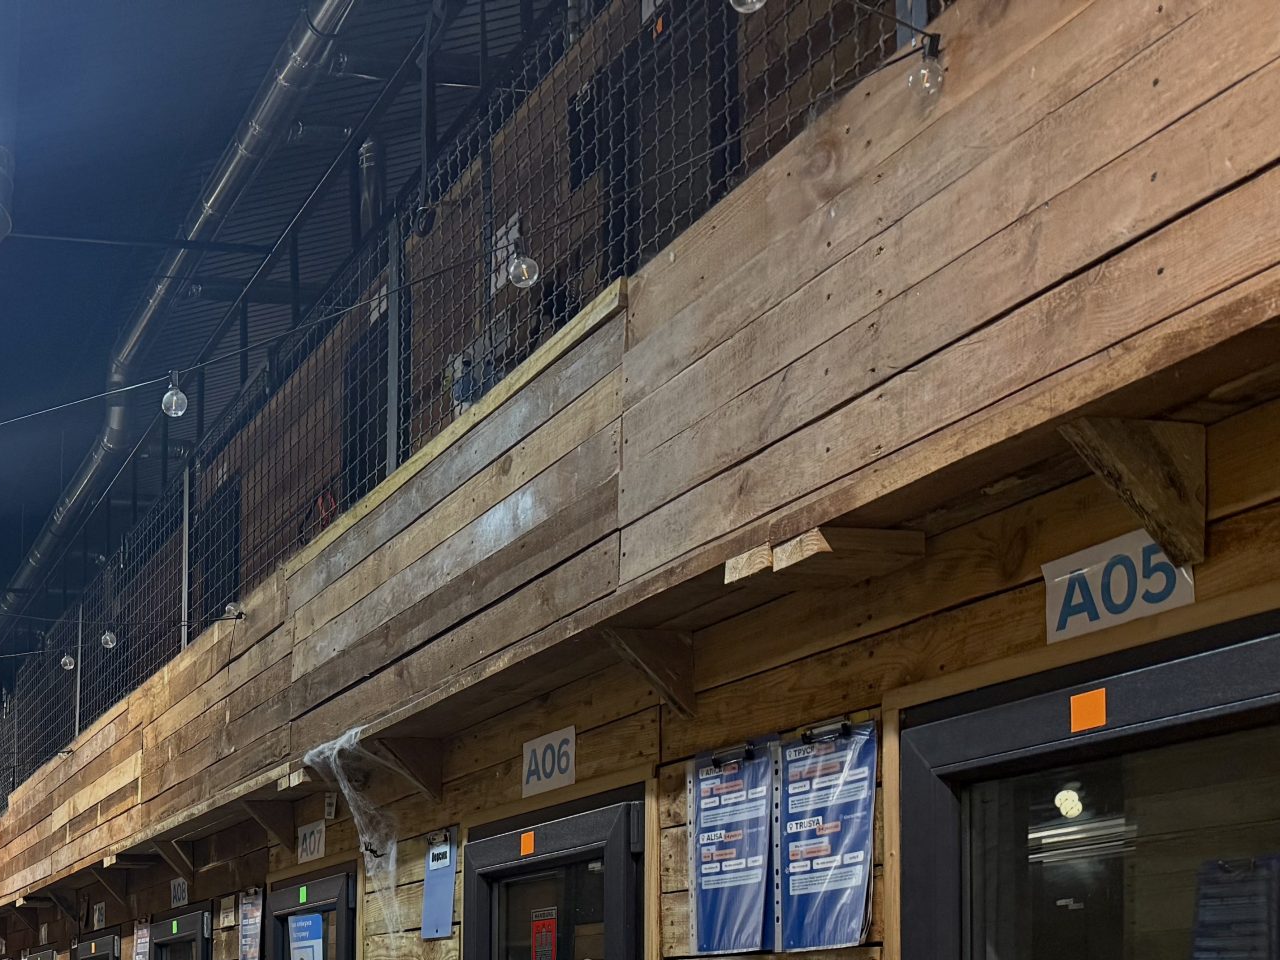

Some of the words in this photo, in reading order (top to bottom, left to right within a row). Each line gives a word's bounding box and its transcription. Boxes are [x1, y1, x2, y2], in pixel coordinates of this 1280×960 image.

[1056, 543, 1177, 632] A05
[526, 738, 570, 785] A06
[706, 832, 723, 842] ALISA
[794, 817, 821, 831] TRUSYA
[300, 830, 323, 859] A07
[173, 878, 187, 904] A08
